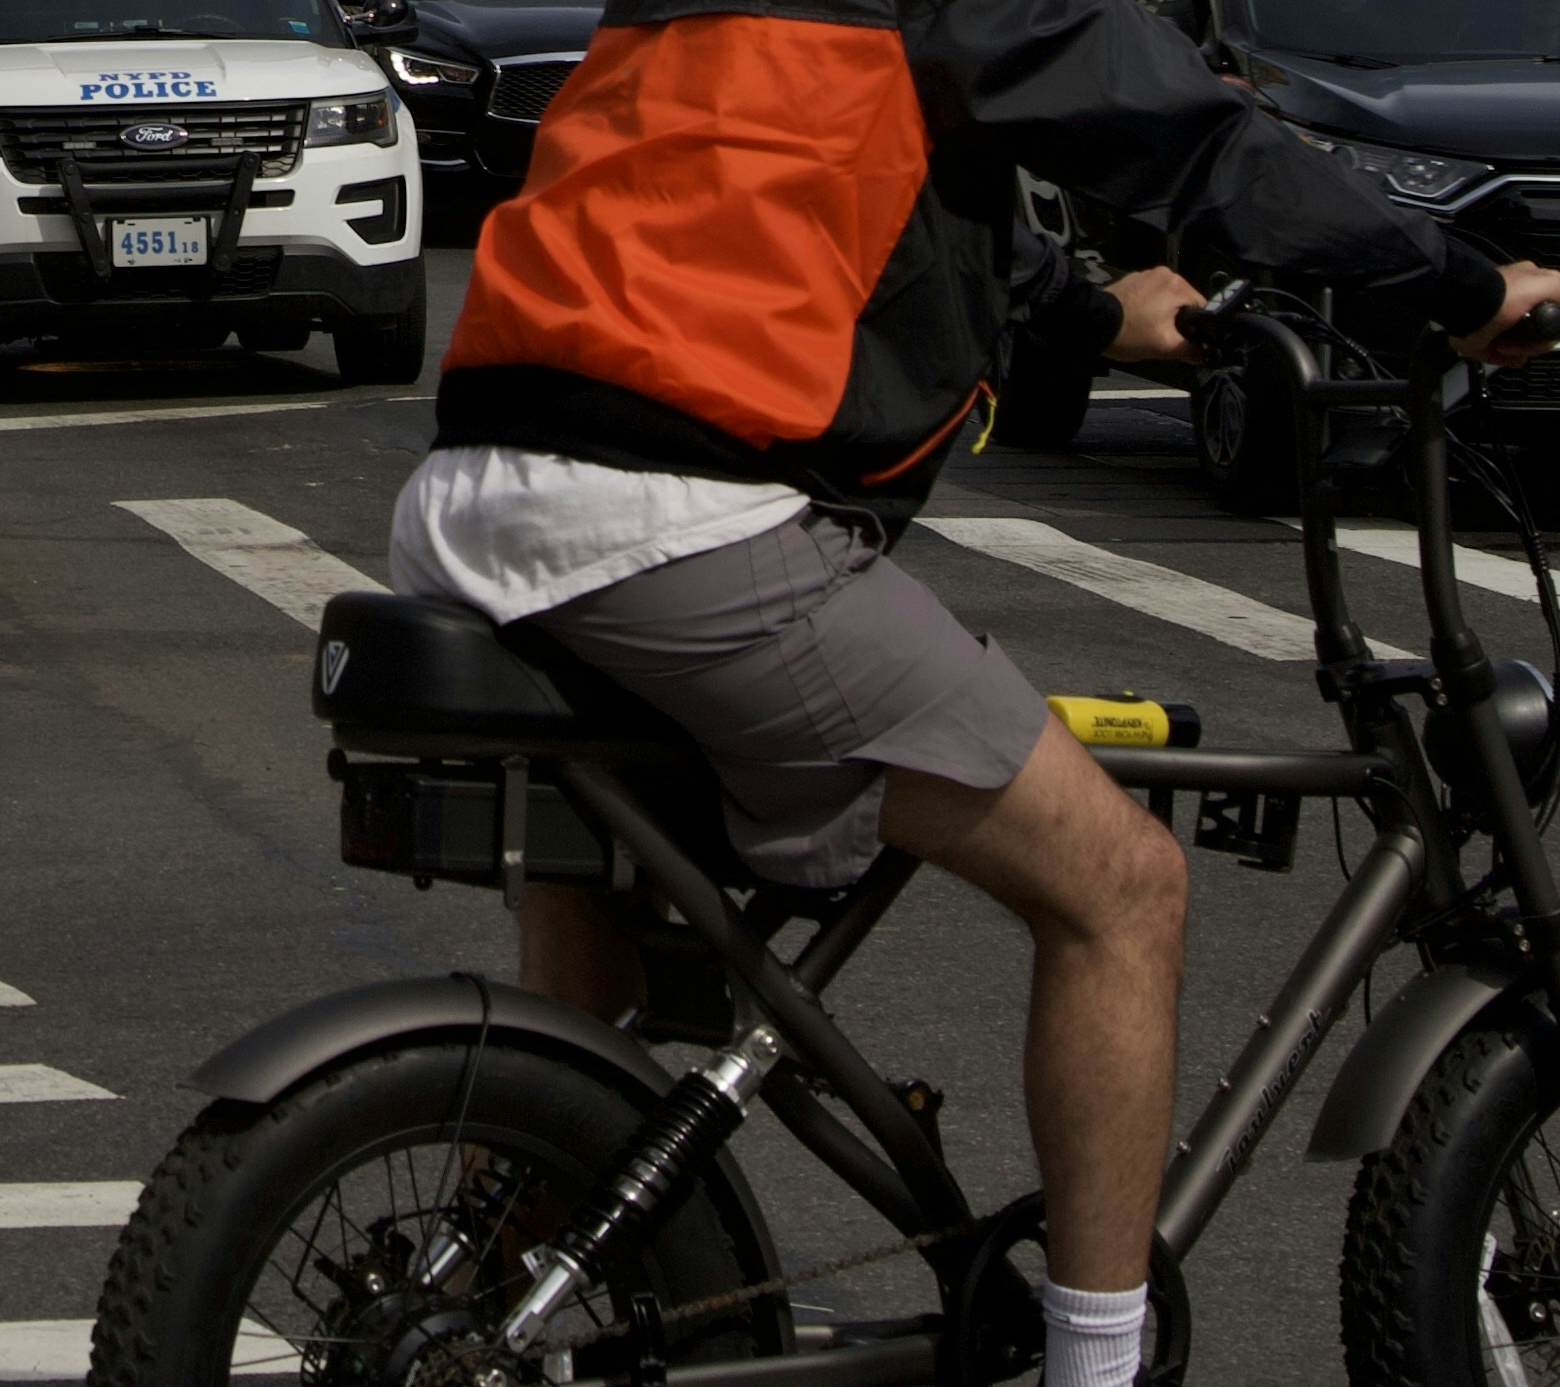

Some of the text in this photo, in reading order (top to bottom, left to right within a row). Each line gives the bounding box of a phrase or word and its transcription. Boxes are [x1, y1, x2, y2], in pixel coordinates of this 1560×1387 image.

[99, 71, 192, 82] NYPD
[80, 81, 218, 101] POLICE
[135, 126, 175, 142] Ford
[121, 231, 200, 255] 4551 18
